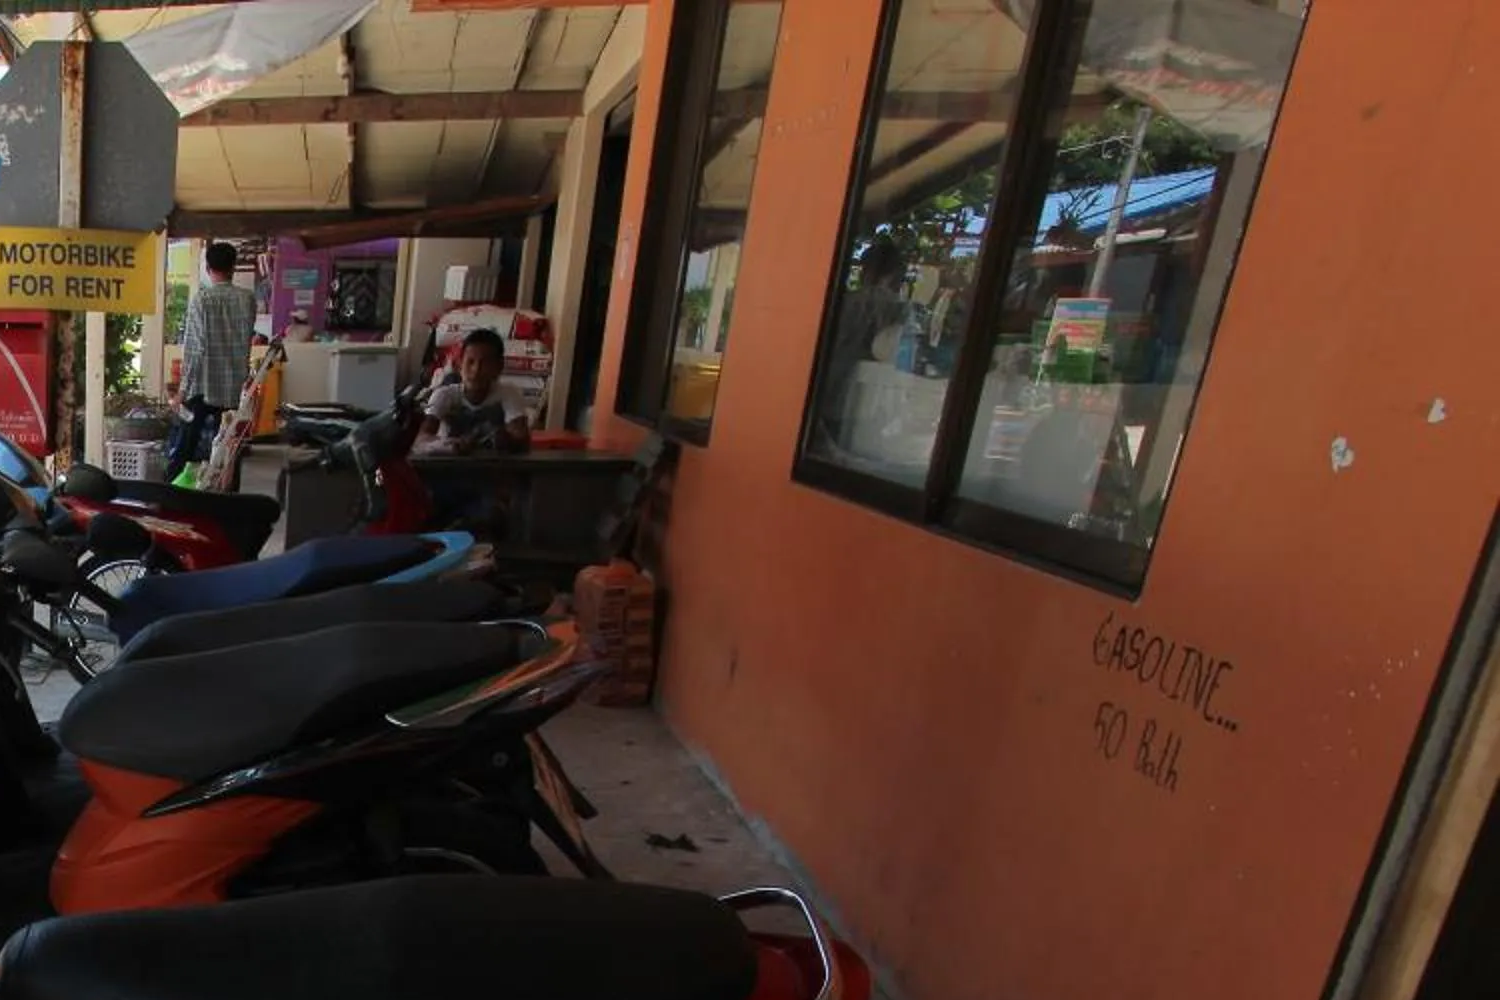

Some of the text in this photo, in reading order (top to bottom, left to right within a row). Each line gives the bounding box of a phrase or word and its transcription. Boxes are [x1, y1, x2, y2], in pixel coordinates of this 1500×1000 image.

[0, 242, 136, 269] MOTORBIKE
[8, 274, 125, 300] FOR RENT
